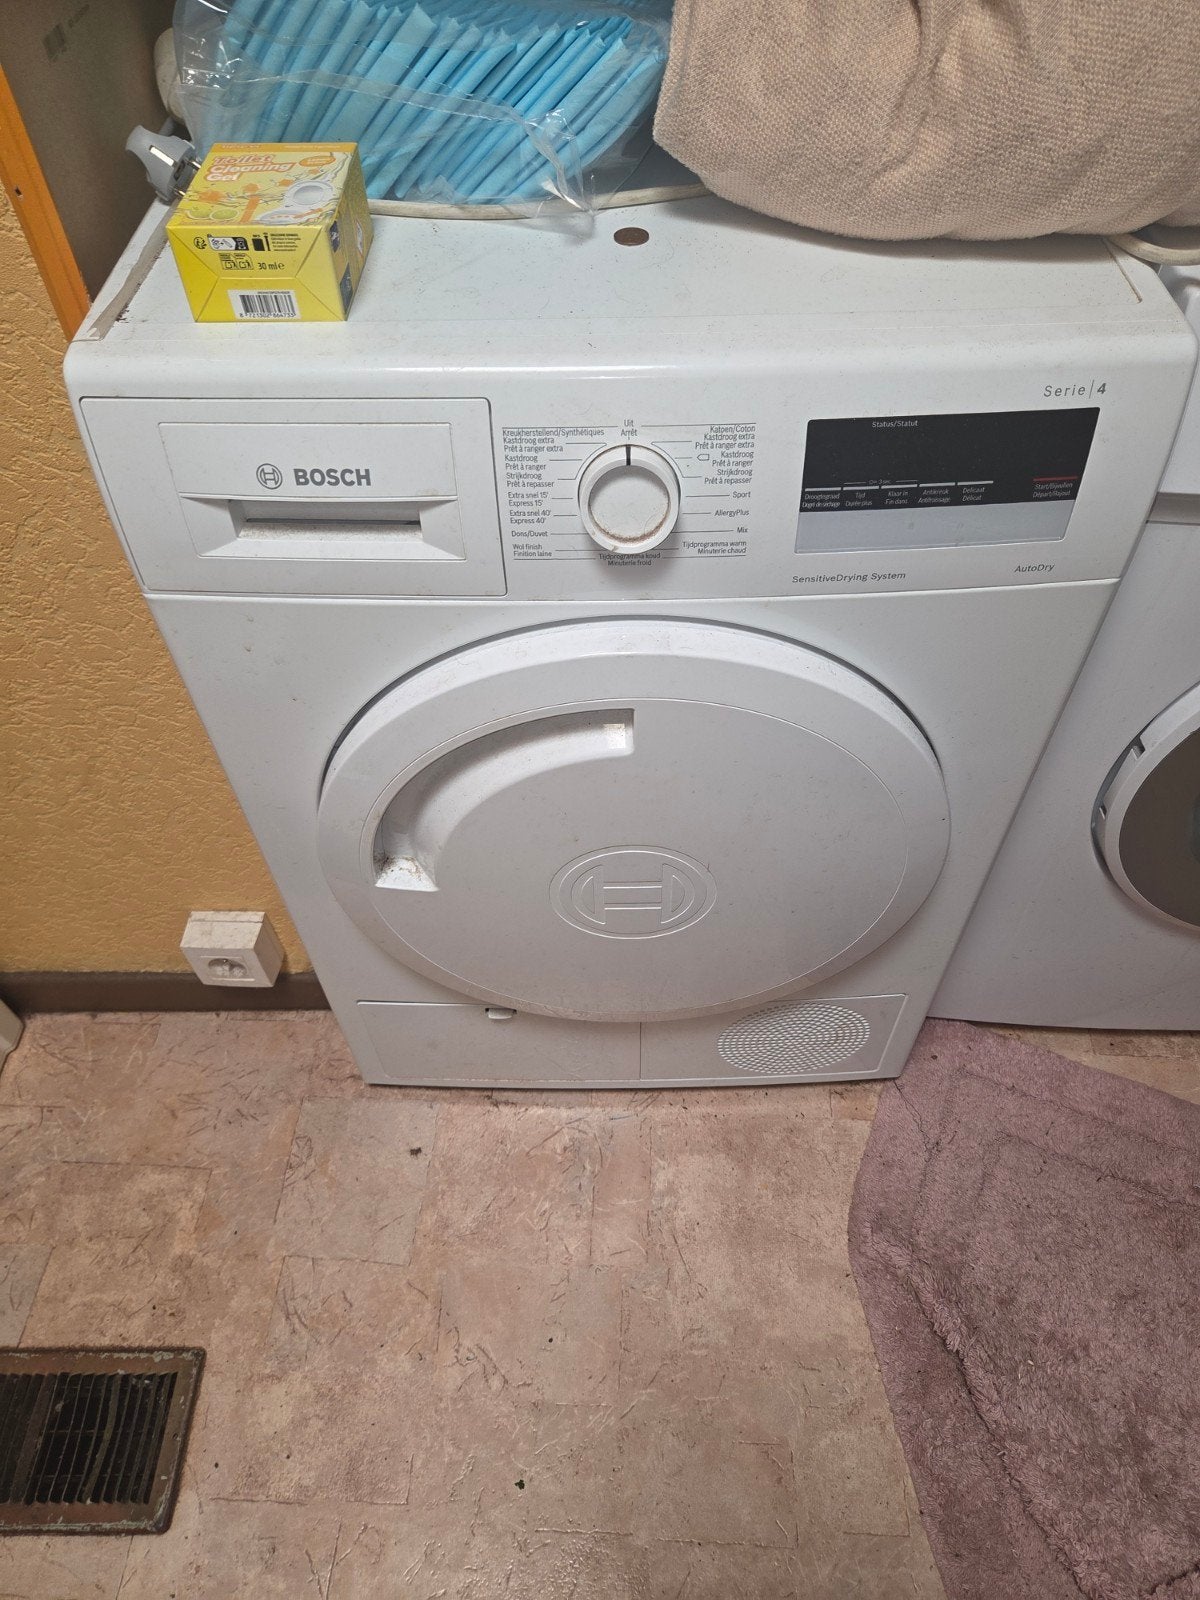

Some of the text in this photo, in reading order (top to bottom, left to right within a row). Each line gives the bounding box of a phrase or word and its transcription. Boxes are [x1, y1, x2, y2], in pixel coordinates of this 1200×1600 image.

[213, 154, 275, 165] Toilet
[210, 163, 292, 173] Cleaning
[206, 172, 240, 181] Gel
[259, 262, 267, 270] 30
[1043, 383, 1107, 398] Serie 4
[623, 419, 634, 427] Uit
[872, 420, 919, 428] Status/Statut
[503, 429, 605, 437] Kreukherstellend/Synthétiques
[620, 428, 638, 437] Arrêt
[710, 425, 756, 433] Katoen/Coton
[504, 437, 537, 445] Kastdroog
[703, 433, 737, 442] Kastdroog
[504, 445, 518, 453] Prêt
[695, 442, 711, 450] Prêt
[716, 443, 736, 451] ranger
[505, 454, 538, 463] Kastdroog
[721, 450, 754, 459] Kastdroog
[525, 464, 546, 472] ranger
[712, 459, 726, 467] Prêt
[732, 460, 753, 468] ranger
[293, 468, 371, 486] BOSCH
[506, 472, 542, 481] Strijkdroog
[717, 468, 753, 477] Strijkdroog
[507, 480, 521, 488] Prêt
[526, 481, 554, 489] repasser
[704, 477, 719, 485] Prêt
[724, 478, 752, 486] repasser
[508, 491, 525, 499] Extra
[732, 491, 751, 499] Sport
[509, 500, 534, 508] Express
[714, 509, 750, 518] AllergyPlus
[510, 517, 535, 525] Express
[511, 530, 548, 538] Dons/Duvet
[683, 541, 729, 549] Tijdprogramma
[1014, 562, 1055, 574] AutoDry
[792, 572, 906, 583] SensitiveDrying System
